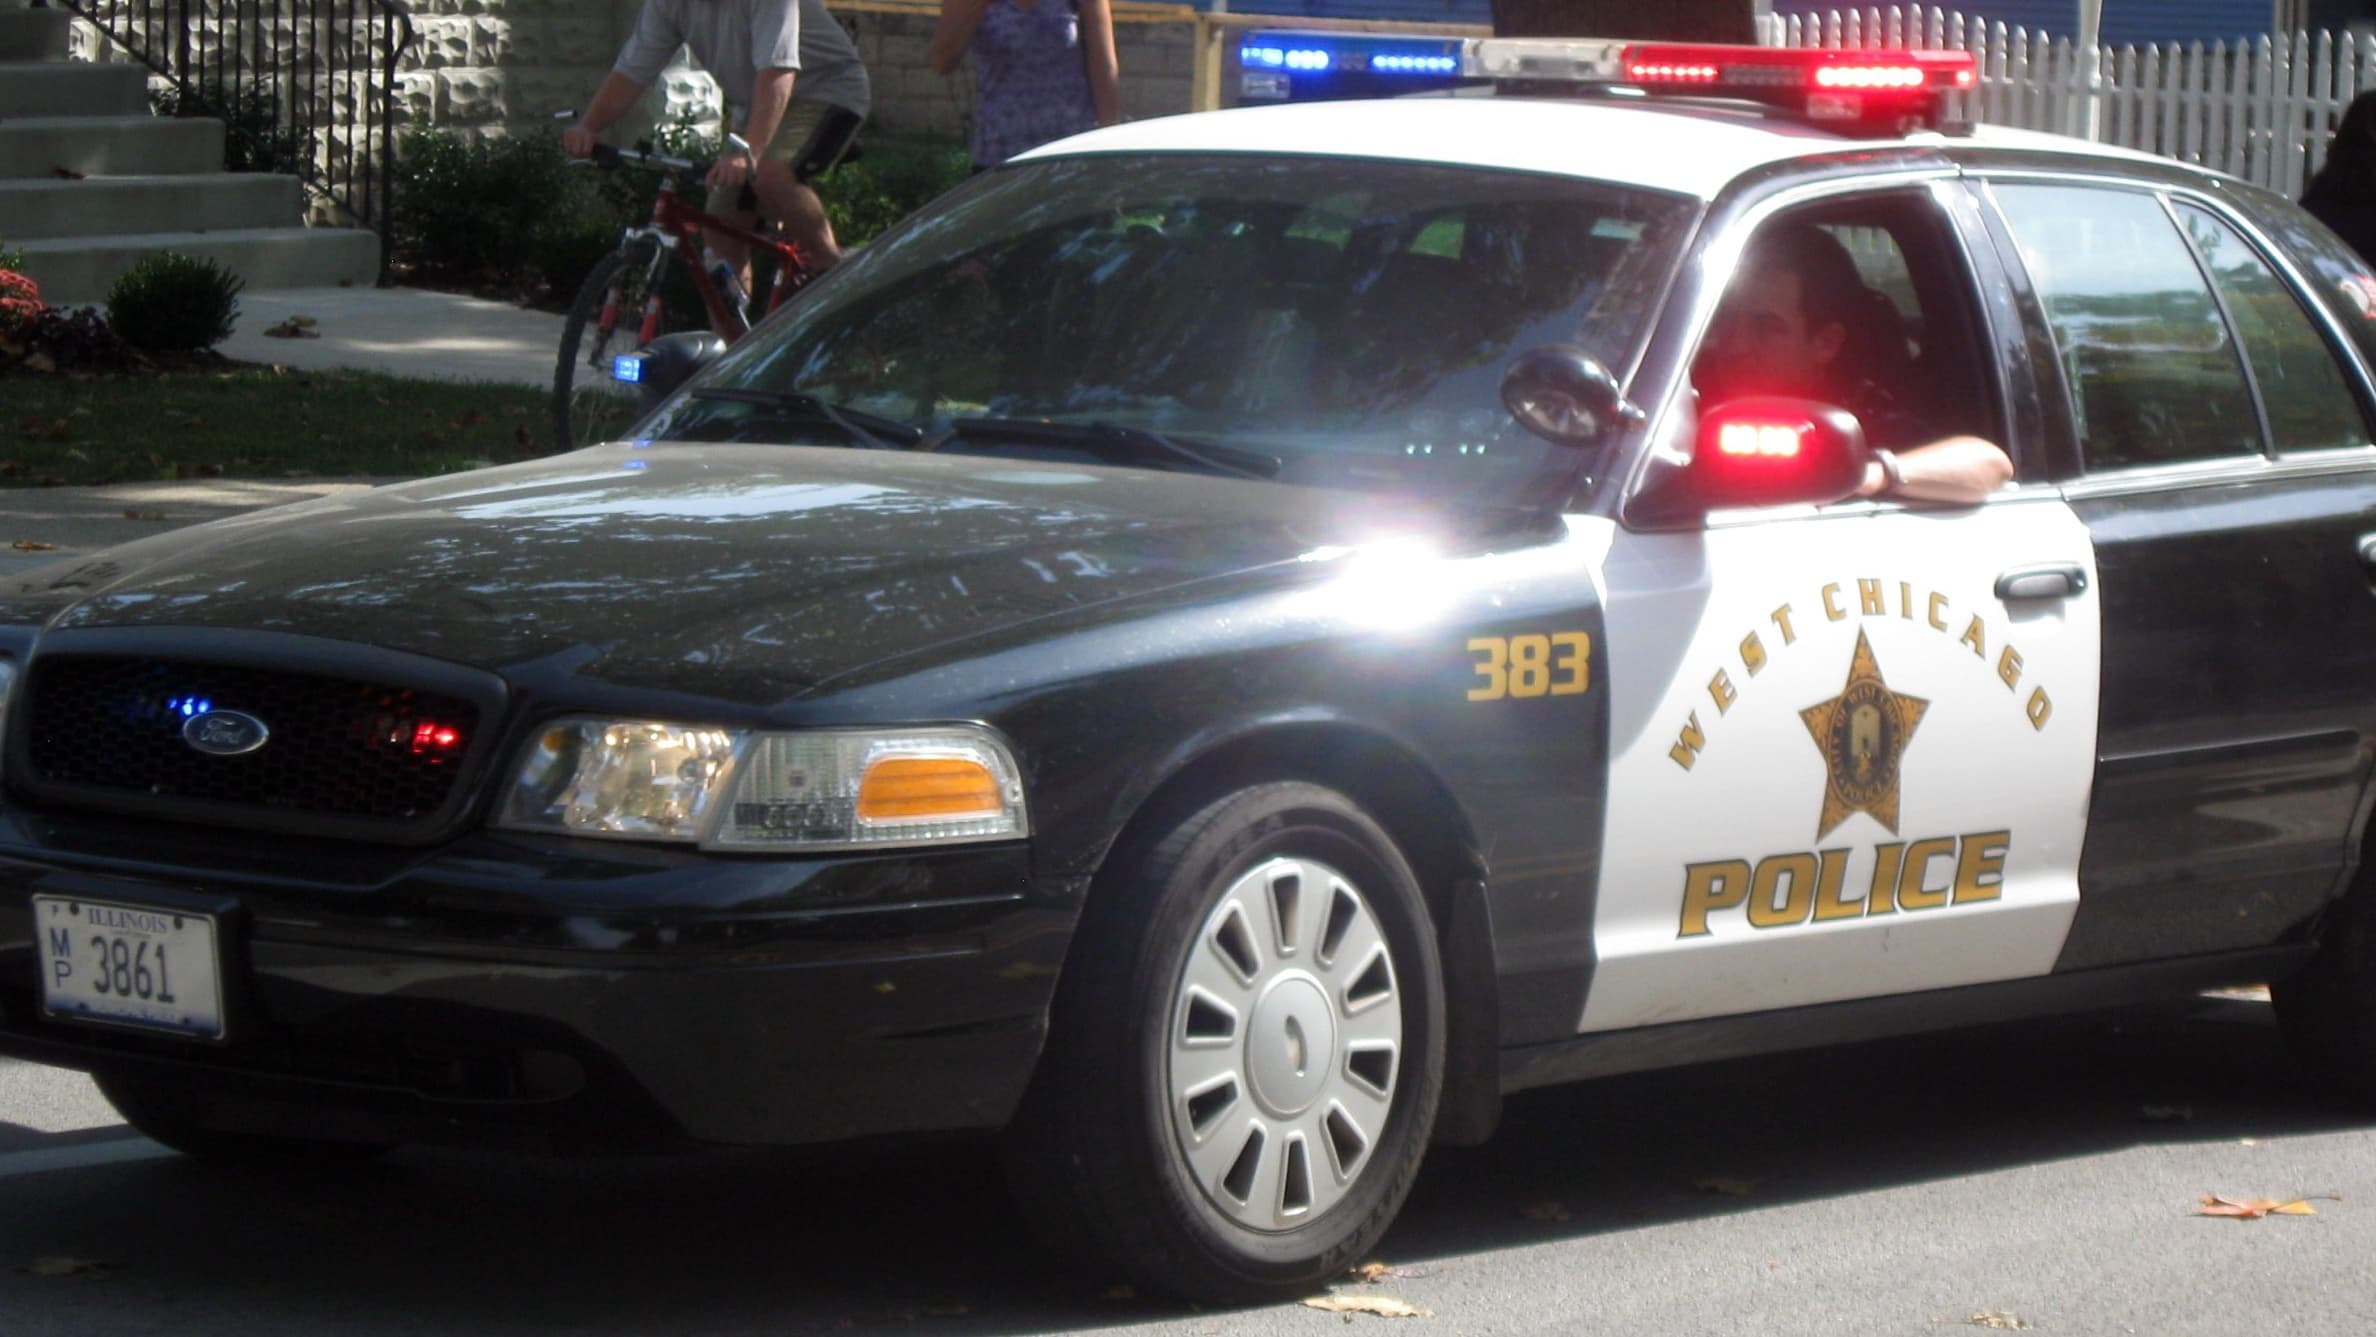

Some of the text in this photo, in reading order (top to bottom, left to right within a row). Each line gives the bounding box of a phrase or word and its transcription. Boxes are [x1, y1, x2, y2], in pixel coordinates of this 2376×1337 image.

[1467, 631, 1591, 701] 383
[1668, 603, 1797, 772] WEST
[1821, 577, 2053, 732] CHICAGO
[1676, 829, 2011, 939] POLICE
[88, 908, 168, 933] ILLINOIS
[91, 936, 175, 1004] 3861
